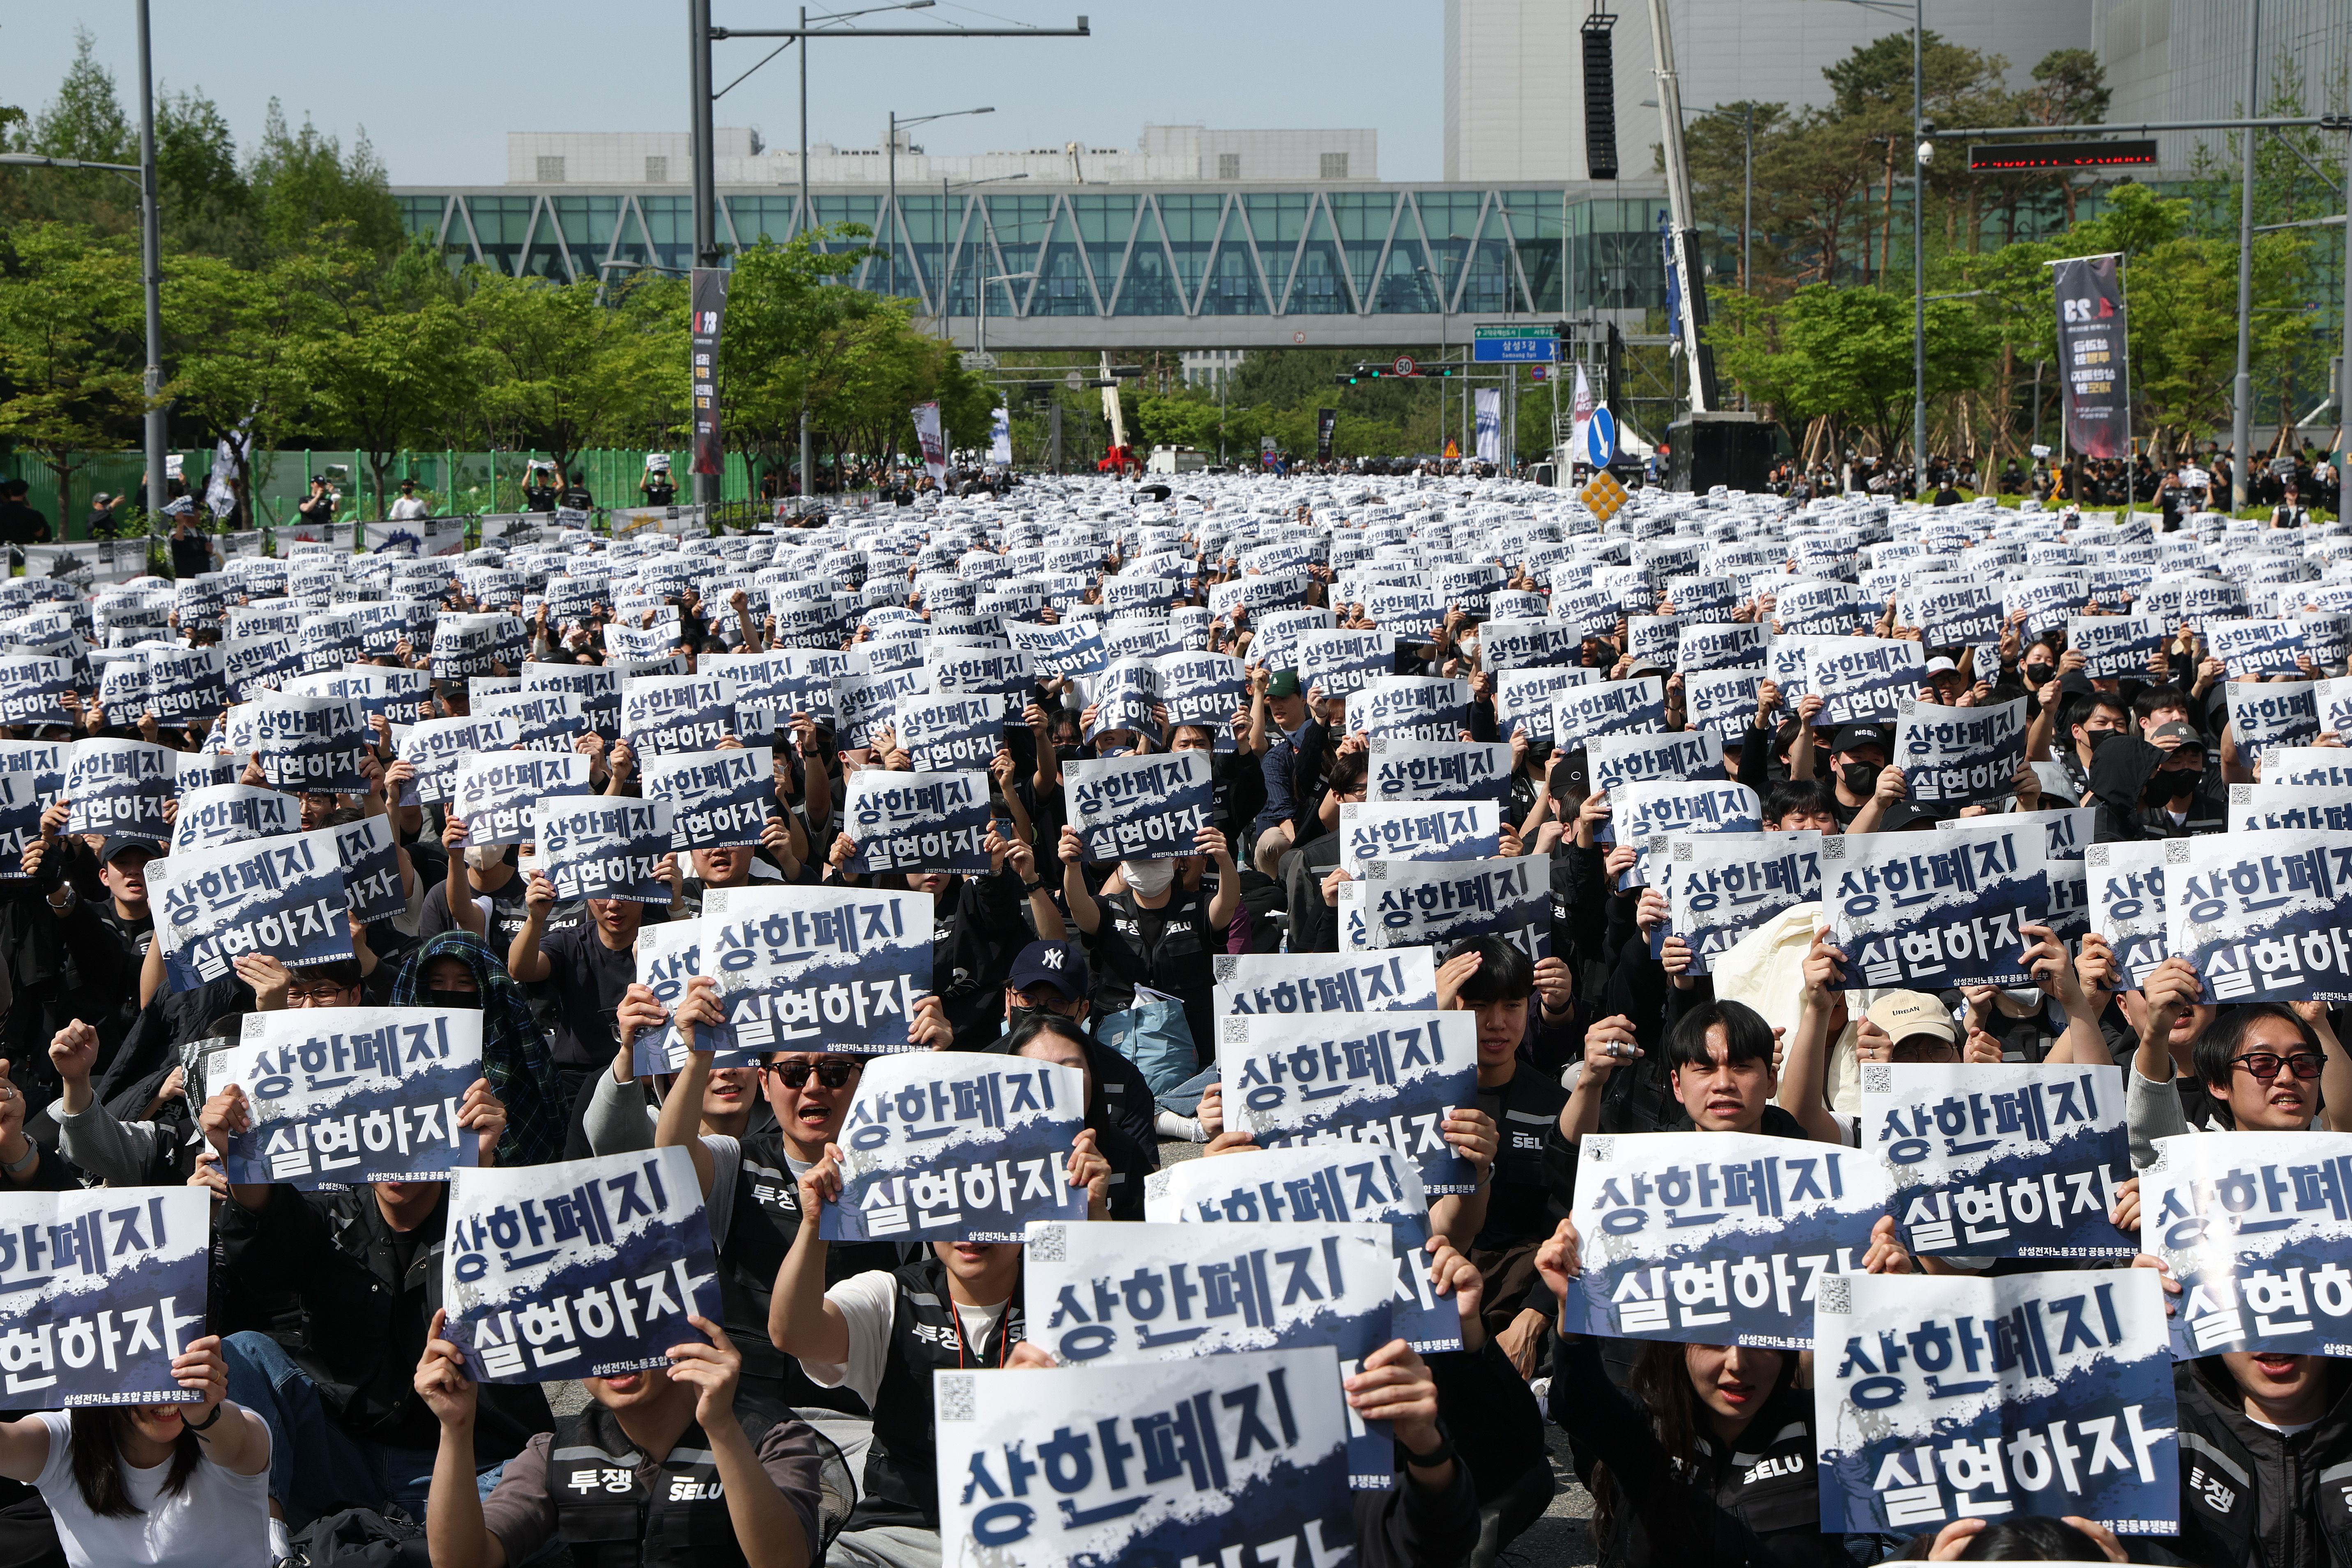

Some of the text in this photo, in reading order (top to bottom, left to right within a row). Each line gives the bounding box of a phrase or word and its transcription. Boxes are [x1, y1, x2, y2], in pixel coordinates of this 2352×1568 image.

[1398, 361, 1410, 372] 50
[822, 555, 863, 572] 상한폐지
[1257, 546, 1304, 567] 상한폐지
[1528, 544, 1577, 566] 상한폐지
[2031, 548, 2080, 565] 상한폐지
[177, 580, 218, 601] 상한폐지
[394, 579, 438, 601] 상한폐지
[477, 573, 519, 587] 상한폐지
[1670, 585, 1730, 605] 상한폐지
[2018, 580, 2081, 609] 상한폐지
[779, 603, 839, 628] 상한폐지
[226, 637, 290, 672] 상한폐지
[1107, 628, 1170, 657] 상한폐지
[1305, 633, 1382, 666] 상한폐지
[1487, 628, 1569, 661] 상한폐지
[1682, 626, 1760, 661] 상한폐지
[1815, 645, 1912, 686] 상한폐지
[628, 682, 722, 721] 상한폐지
[902, 696, 988, 737] 상한폐지
[1164, 693, 1242, 723] 실현하자
[1370, 683, 1454, 717] 상한폐지
[1561, 682, 1647, 730] 상한폐지
[1827, 681, 1922, 722] 실현하자
[257, 704, 354, 740] 상한폐지
[408, 721, 503, 764] 상한폐지
[633, 719, 732, 758] 실현하자
[1905, 705, 2015, 755] 상한폐지
[68, 746, 164, 786] 상한폐지
[263, 748, 364, 785] 실현하자
[911, 736, 1001, 773] 실현하자
[1378, 747, 1494, 794] 상한폐지
[1597, 737, 1709, 790] 상한폐지
[1912, 750, 2023, 800] 실현하자
[464, 758, 570, 803] 상한폐지
[651, 758, 756, 803] 상한폐지
[855, 778, 972, 824] 상한폐지
[1075, 756, 1193, 815] 상한폐지
[67, 794, 163, 832] 실현하자
[178, 797, 286, 846] 상한폐지
[545, 803, 655, 852] 상한폐지
[672, 798, 776, 848] 실현하자
[1350, 806, 1478, 858] 상한폐지
[1623, 788, 1748, 836] 상한폐지
[719, 838, 753, 847] 삼성전자노동조합
[864, 826, 989, 872] 실현하자
[1090, 809, 1210, 858] 실현하자
[1152, 849, 1188, 858] 삼성전자노동조합
[164, 838, 314, 928] 상한폐지
[555, 853, 660, 900] 실현하자
[1378, 854, 1527, 931] 상한폐지
[1836, 834, 2018, 916] 상한폐지
[611, 893, 672, 904] 삼성전자노동조합 공동투쟁본부
[192, 899, 346, 984] 실현하자
[499, 920, 525, 932] 투쟁
[715, 898, 905, 971] 상한폐지
[1859, 905, 2046, 986] 실현하자
[317, 952, 353, 964] 공동투쟁본부
[2206, 926, 2352, 1000] 실현하
[1953, 975, 2008, 986] 삼성전자노동조합
[731, 973, 932, 1048] 실현하자
[1893, 1006, 1919, 1015] URBAN
[249, 1016, 449, 1100] 상한폐지
[827, 1042, 931, 1053] 삼성전자노동조합 공동투쟁본부
[1237, 1020, 1445, 1112] 상한폐지
[846, 1069, 1055, 1150] 상한폐지
[1879, 1073, 2098, 1164] 상한폐지
[265, 1096, 461, 1180] 실현하자
[1512, 1131, 1543, 1149] SEL
[367, 1171, 428, 1182] 삼성전자노동조합
[860, 1151, 1071, 1237] 실현하자
[1432, 1183, 1476, 1194] 공동투쟁본부
[1592, 1153, 1843, 1235] 상한폐지
[452, 1158, 668, 1284] 상한폐지
[1903, 1164, 2126, 1253] 실현하자
[2156, 1155, 2352, 1250] 상한폐
[0, 1198, 168, 1291] 한폐지
[968, 1231, 1026, 1242] 삼성전자노동조
[2017, 1246, 2139, 1258] 삼성전자노동조합 공동투쟁본부
[472, 1257, 718, 1379] 실현하자
[1048, 1236, 1348, 1362] 상한폐지
[0, 1296, 204, 1395] 현하자
[1738, 1334, 1815, 1349] 삼성전자노동조합
[1837, 1282, 2122, 1410] 상한폐지
[592, 1355, 668, 1375] 삼성전자노동조합
[64, 1389, 200, 1405] 삼성전자노동조합 공동투쟁본부
[960, 1367, 1300, 1548] 상한폐지
[1873, 1405, 2178, 1528] 실현하자
[568, 1468, 632, 1495] 투쟁
[670, 1476, 723, 1502] SELU
[2116, 1519, 2178, 1534] 공동투쟁본부
